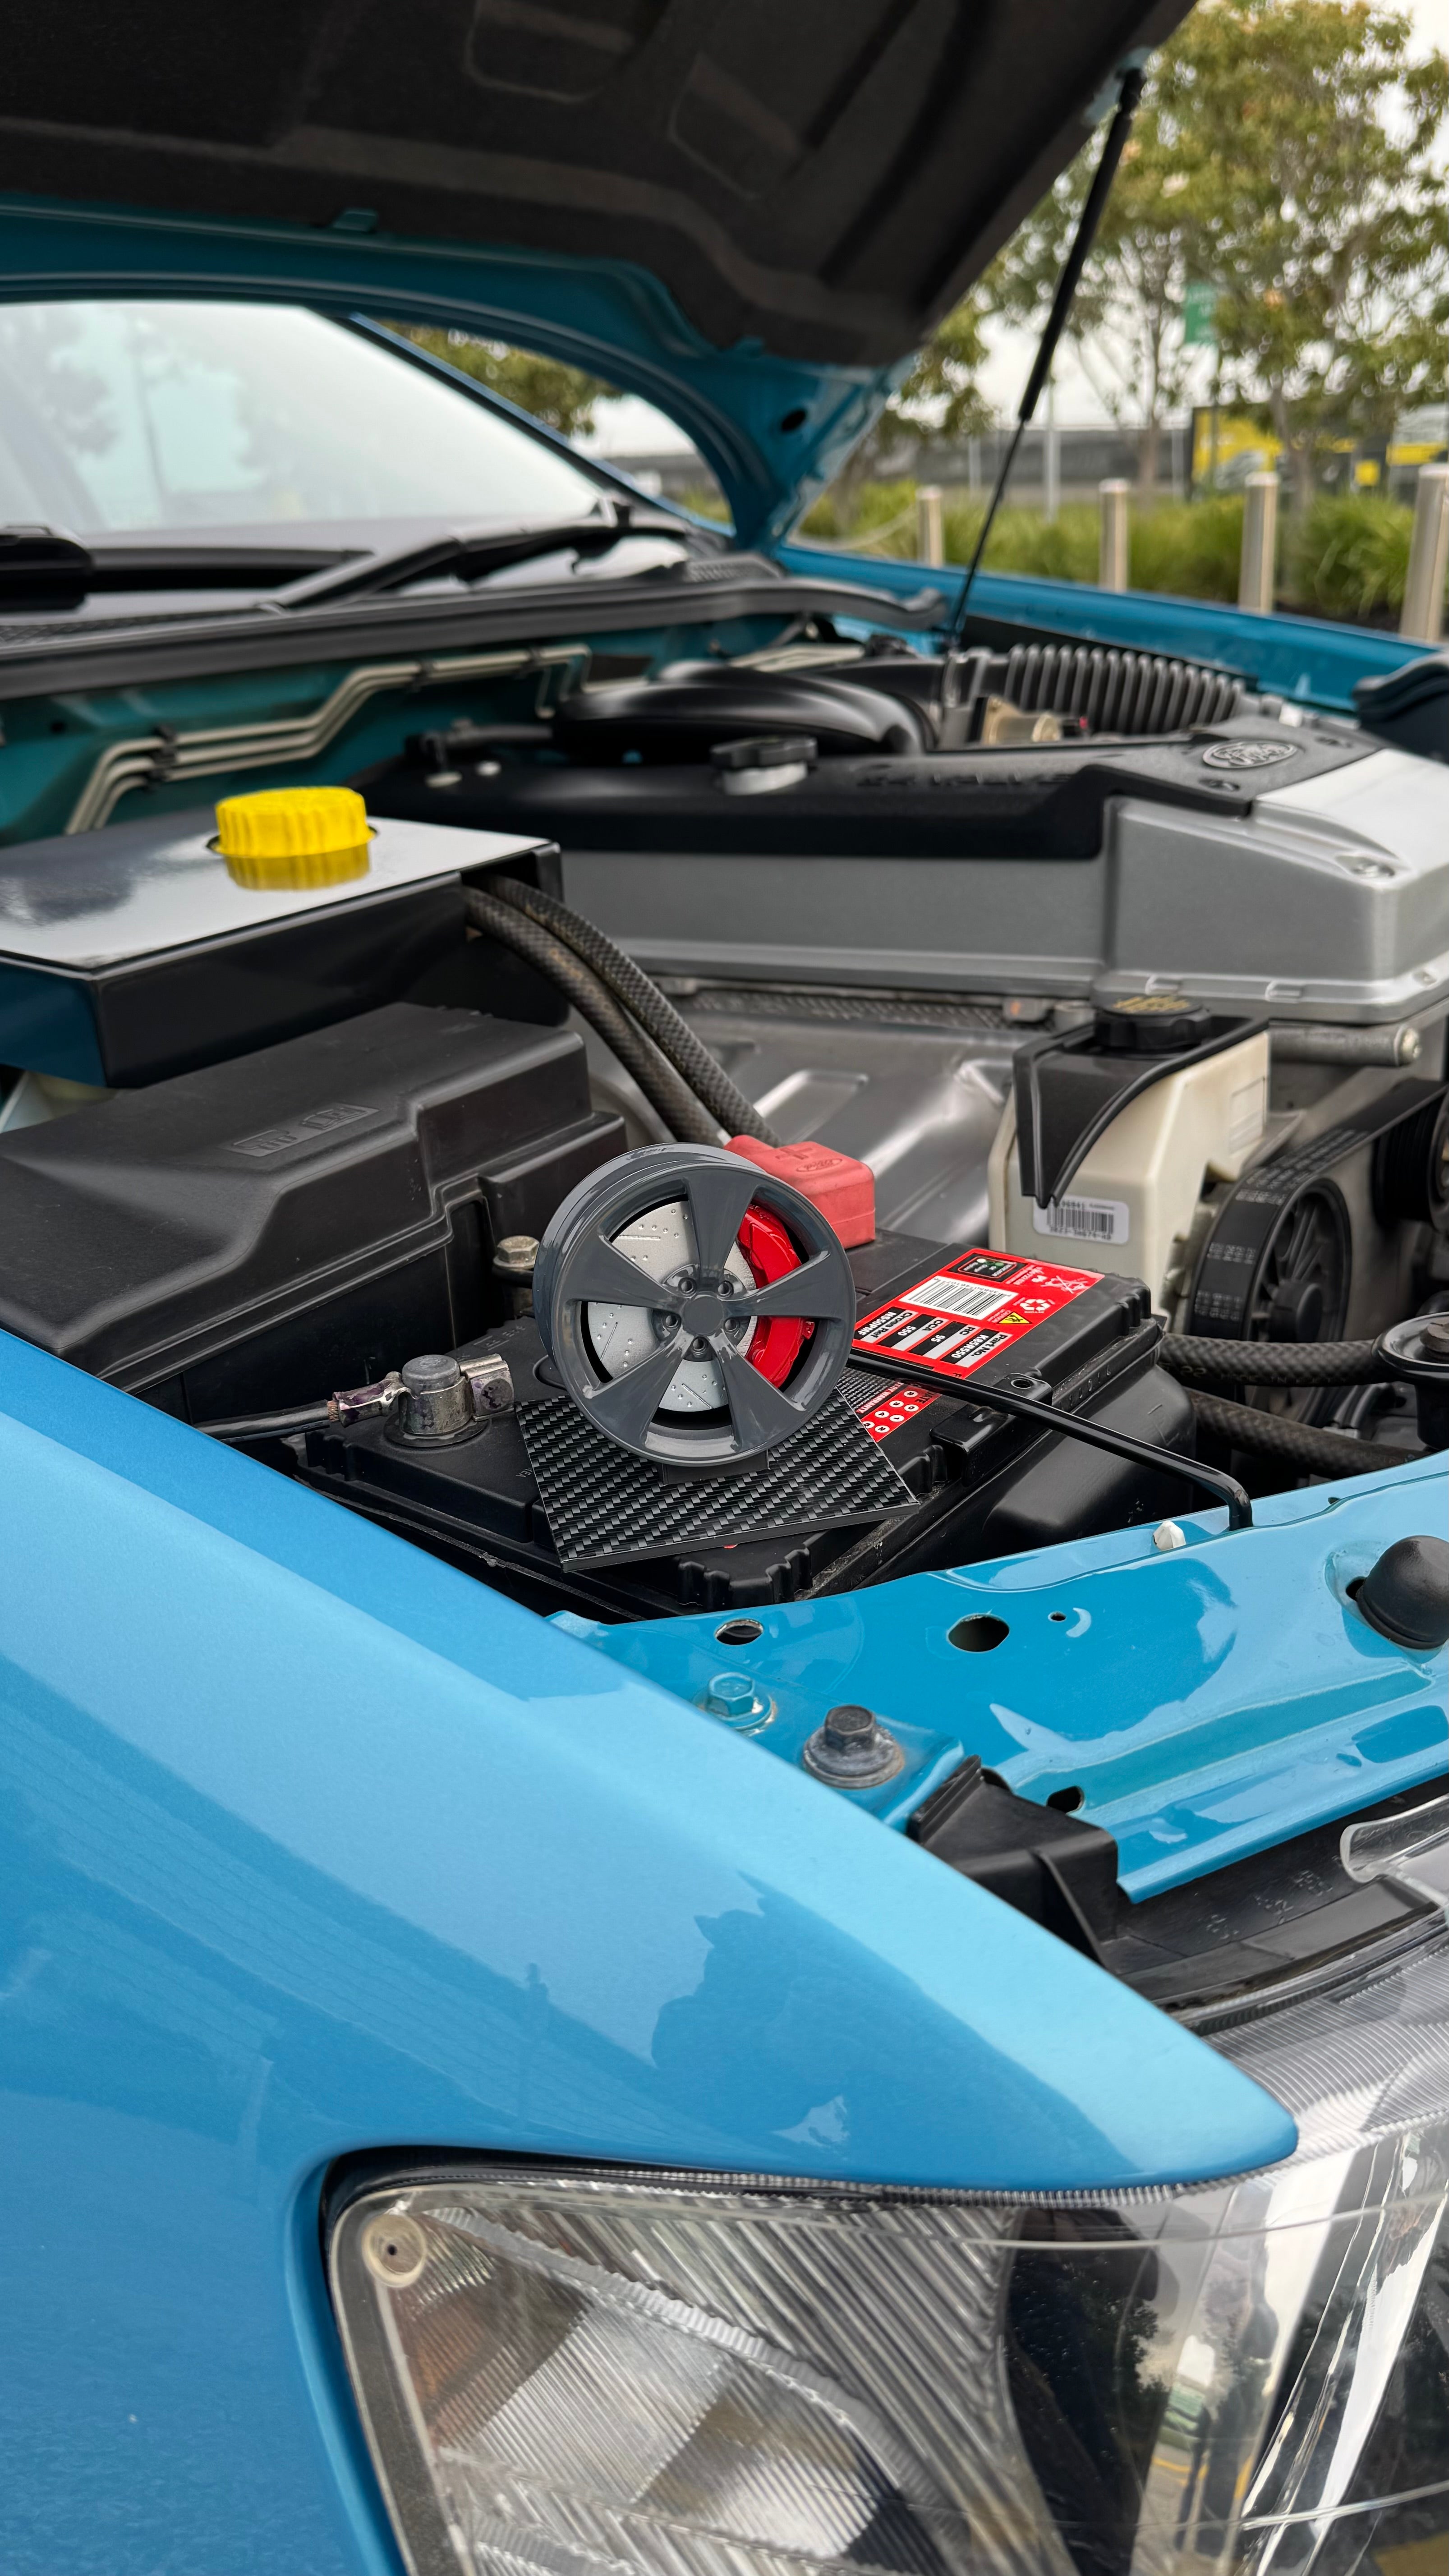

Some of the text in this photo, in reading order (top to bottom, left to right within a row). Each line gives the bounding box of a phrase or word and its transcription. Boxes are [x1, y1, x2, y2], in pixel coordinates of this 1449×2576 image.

[858, 1311, 897, 1335] NS50PMF
[870, 1312, 913, 1338] Cross Ref
[897, 1325, 916, 1336] 550
[922, 1320, 943, 1331] CCA
[959, 1326, 975, 1335] RC
[930, 1334, 946, 1343] 95
[951, 1334, 989, 1358] K85R550
[971, 1334, 1008, 1356] Part No.
